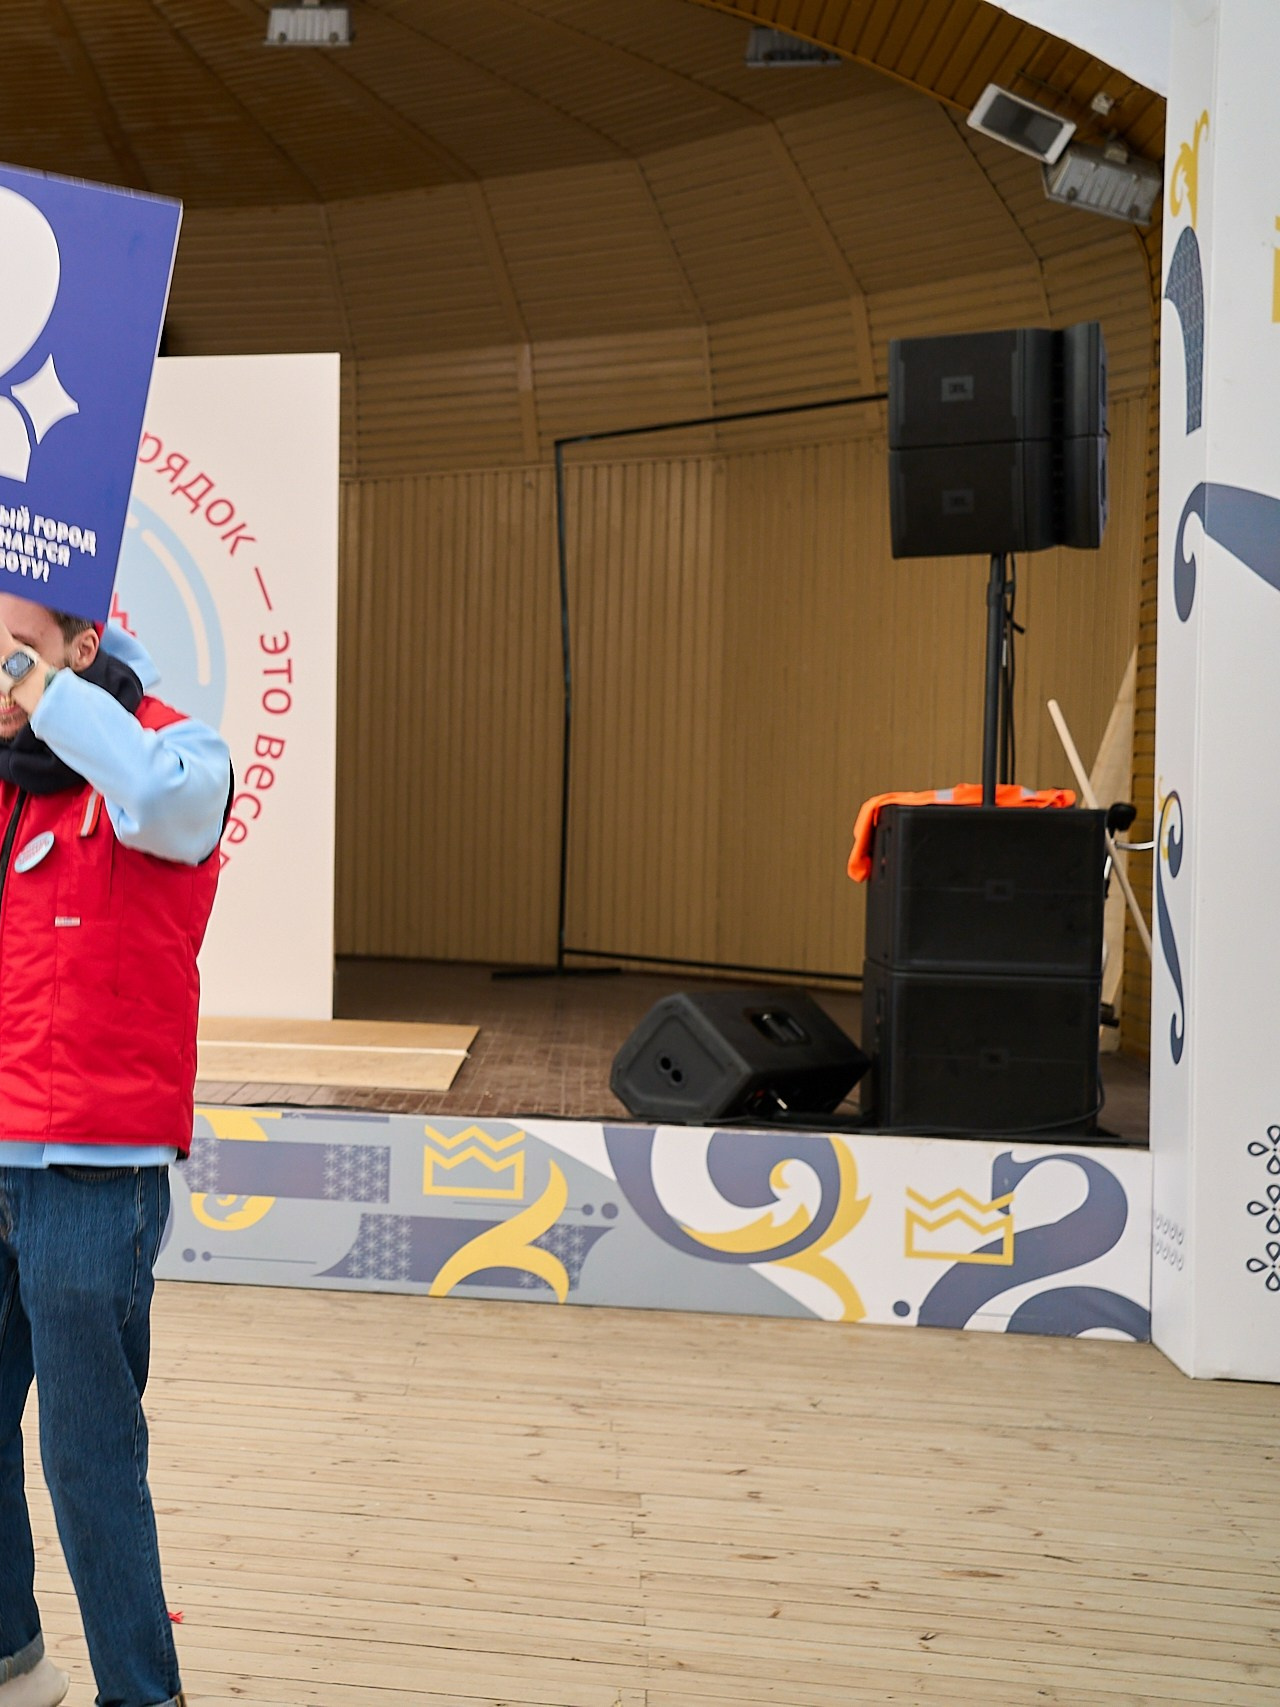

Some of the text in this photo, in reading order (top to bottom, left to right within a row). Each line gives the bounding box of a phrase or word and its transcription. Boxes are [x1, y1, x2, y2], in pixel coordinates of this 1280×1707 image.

[33, 514, 97, 557] ГОРОД
[138, 431, 257, 557] рядок
[259, 630, 293, 716] это
